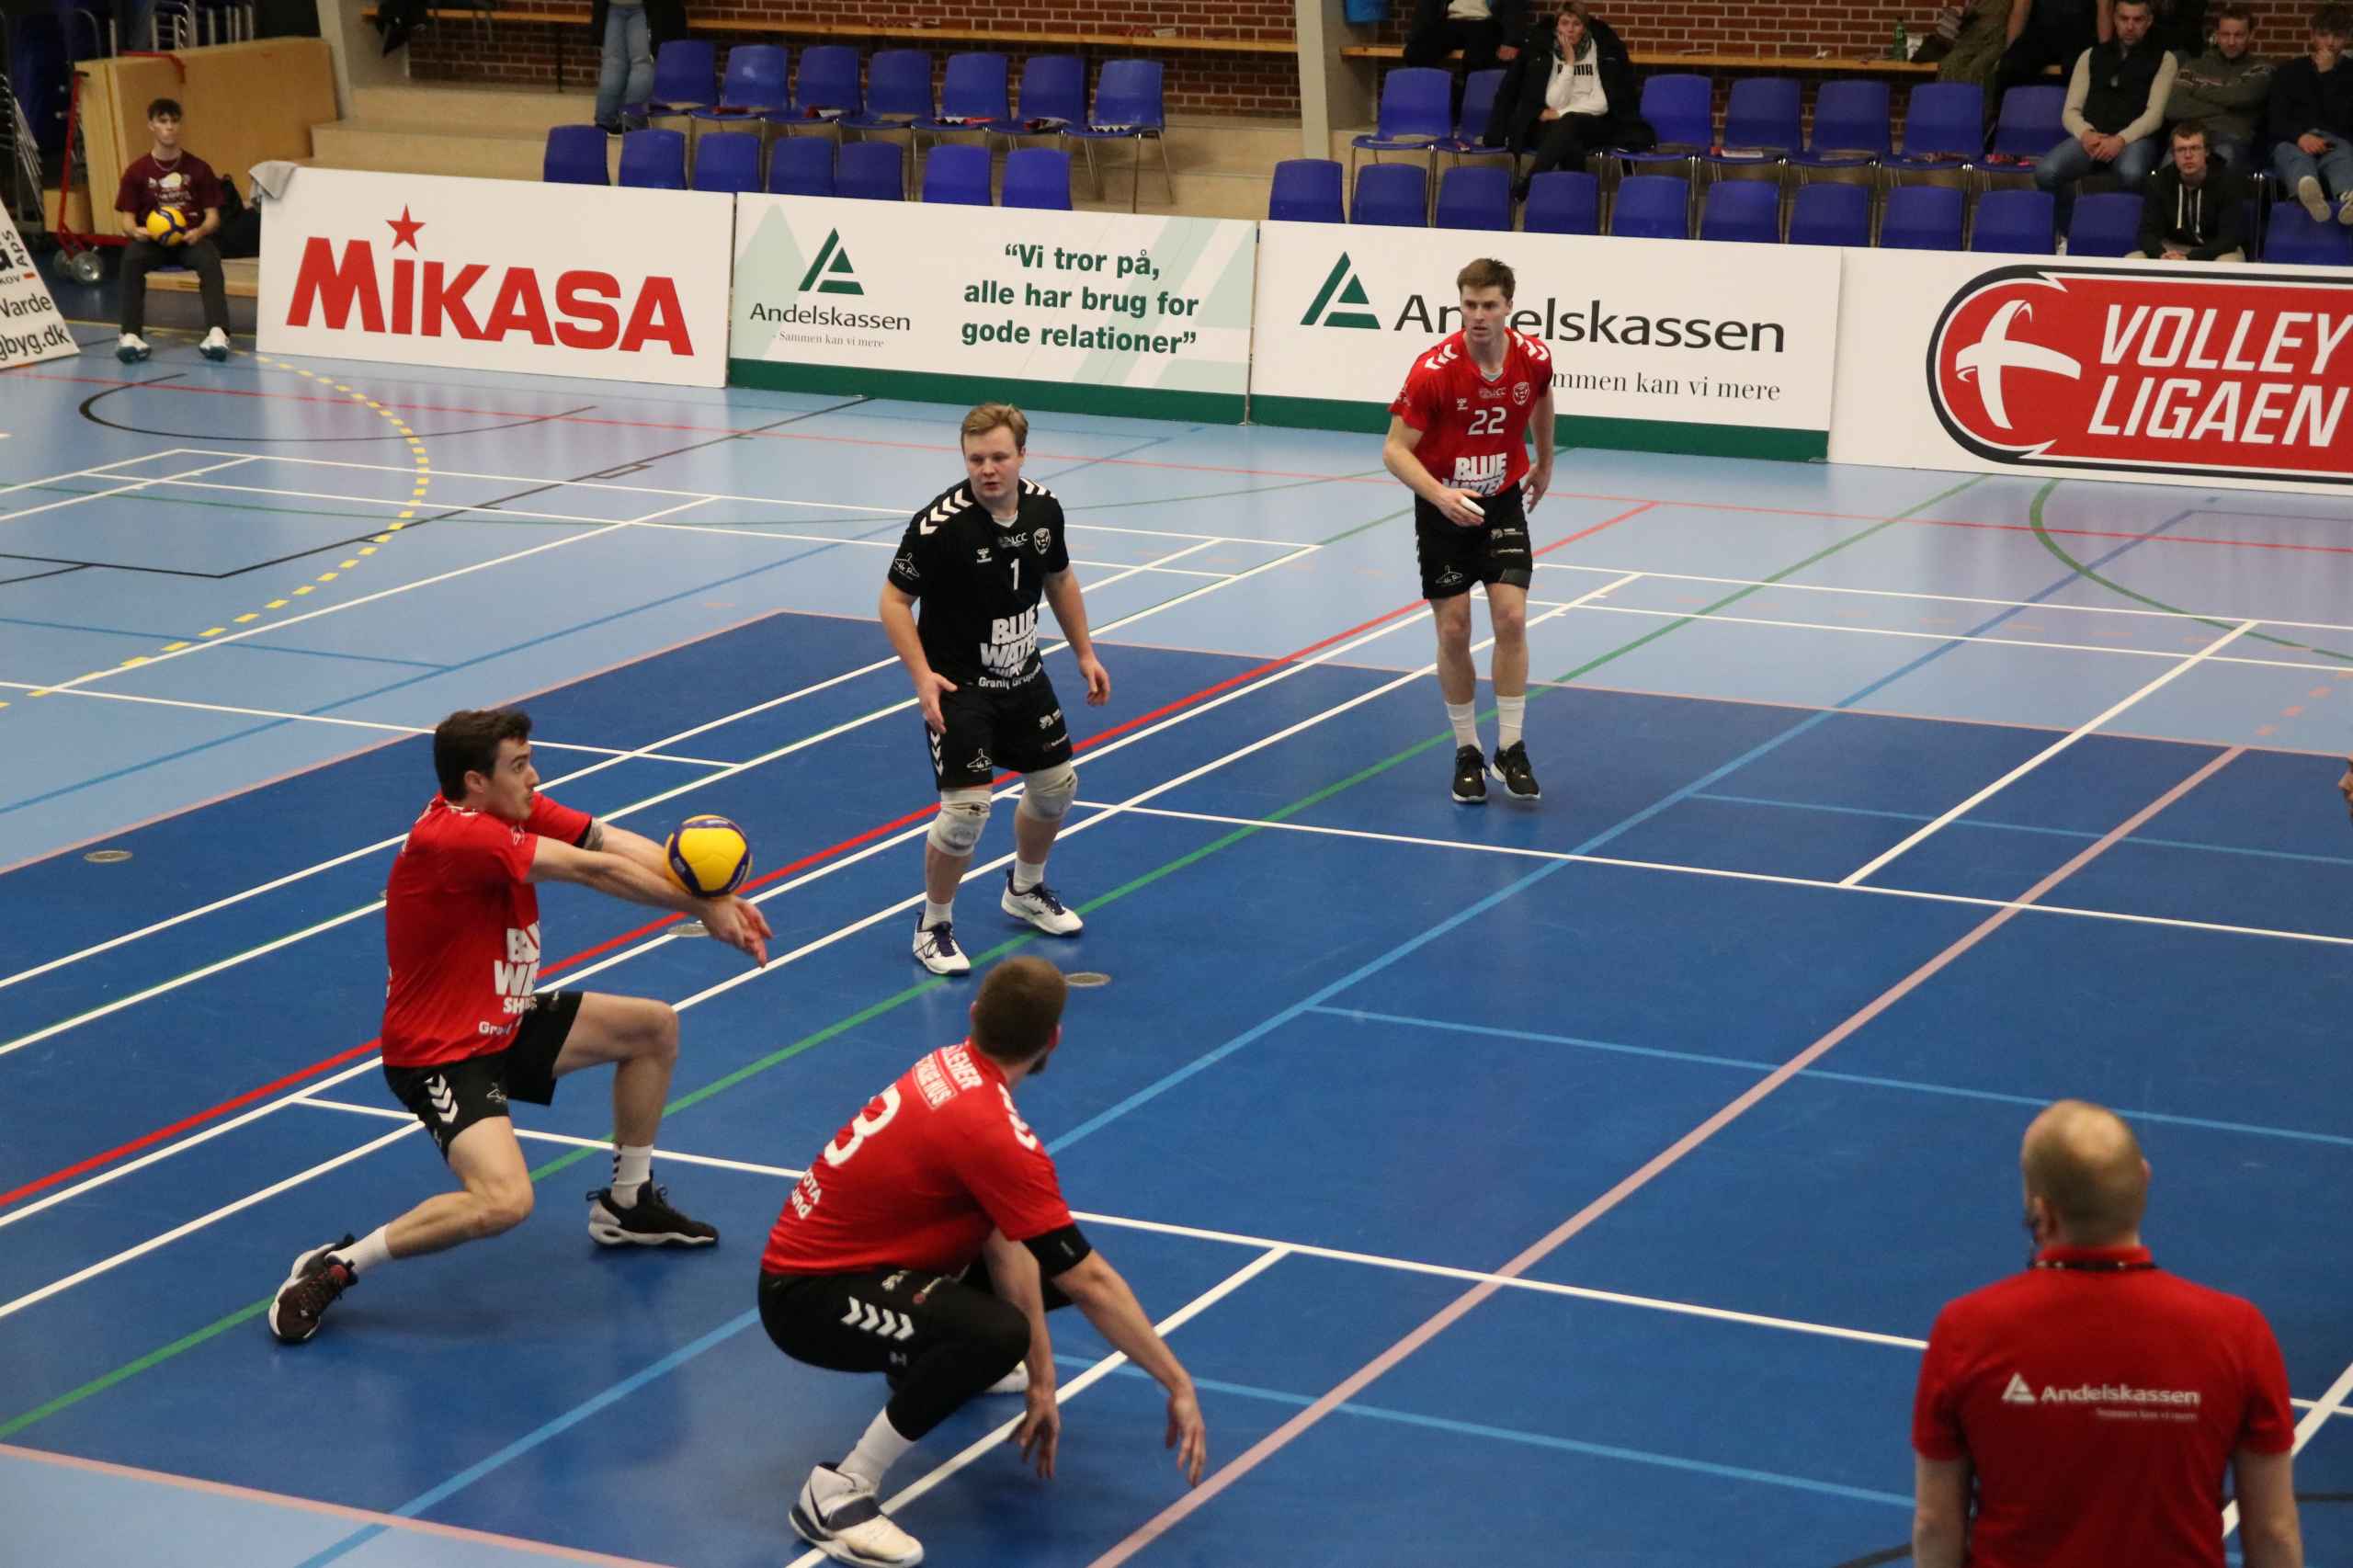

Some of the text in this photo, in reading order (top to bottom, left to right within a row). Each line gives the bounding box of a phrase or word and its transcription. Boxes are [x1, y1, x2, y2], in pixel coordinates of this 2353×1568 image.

[1558, 63, 1594, 75] PMA
[1054, 247, 1108, 272] tror
[1117, 249, 1160, 280] på,
[964, 280, 1199, 319] alle har brug for
[750, 302, 911, 331] Andelskassen
[1394, 294, 1785, 353] Anelskassen
[779, 331, 885, 347] Sammen kan vi mere
[961, 320, 1030, 346] gode
[2100, 304, 2353, 375] VOLLEY
[1552, 371, 1781, 402] mmen kan vi mere
[1468, 406, 1507, 436] 22
[2087, 375, 2350, 448] LIGAEN
[1453, 452, 1507, 481] BLUE
[1010, 558, 1020, 590] 1
[824, 1083, 902, 1167] 3
[2040, 1383, 2201, 1406] Andelskassen
